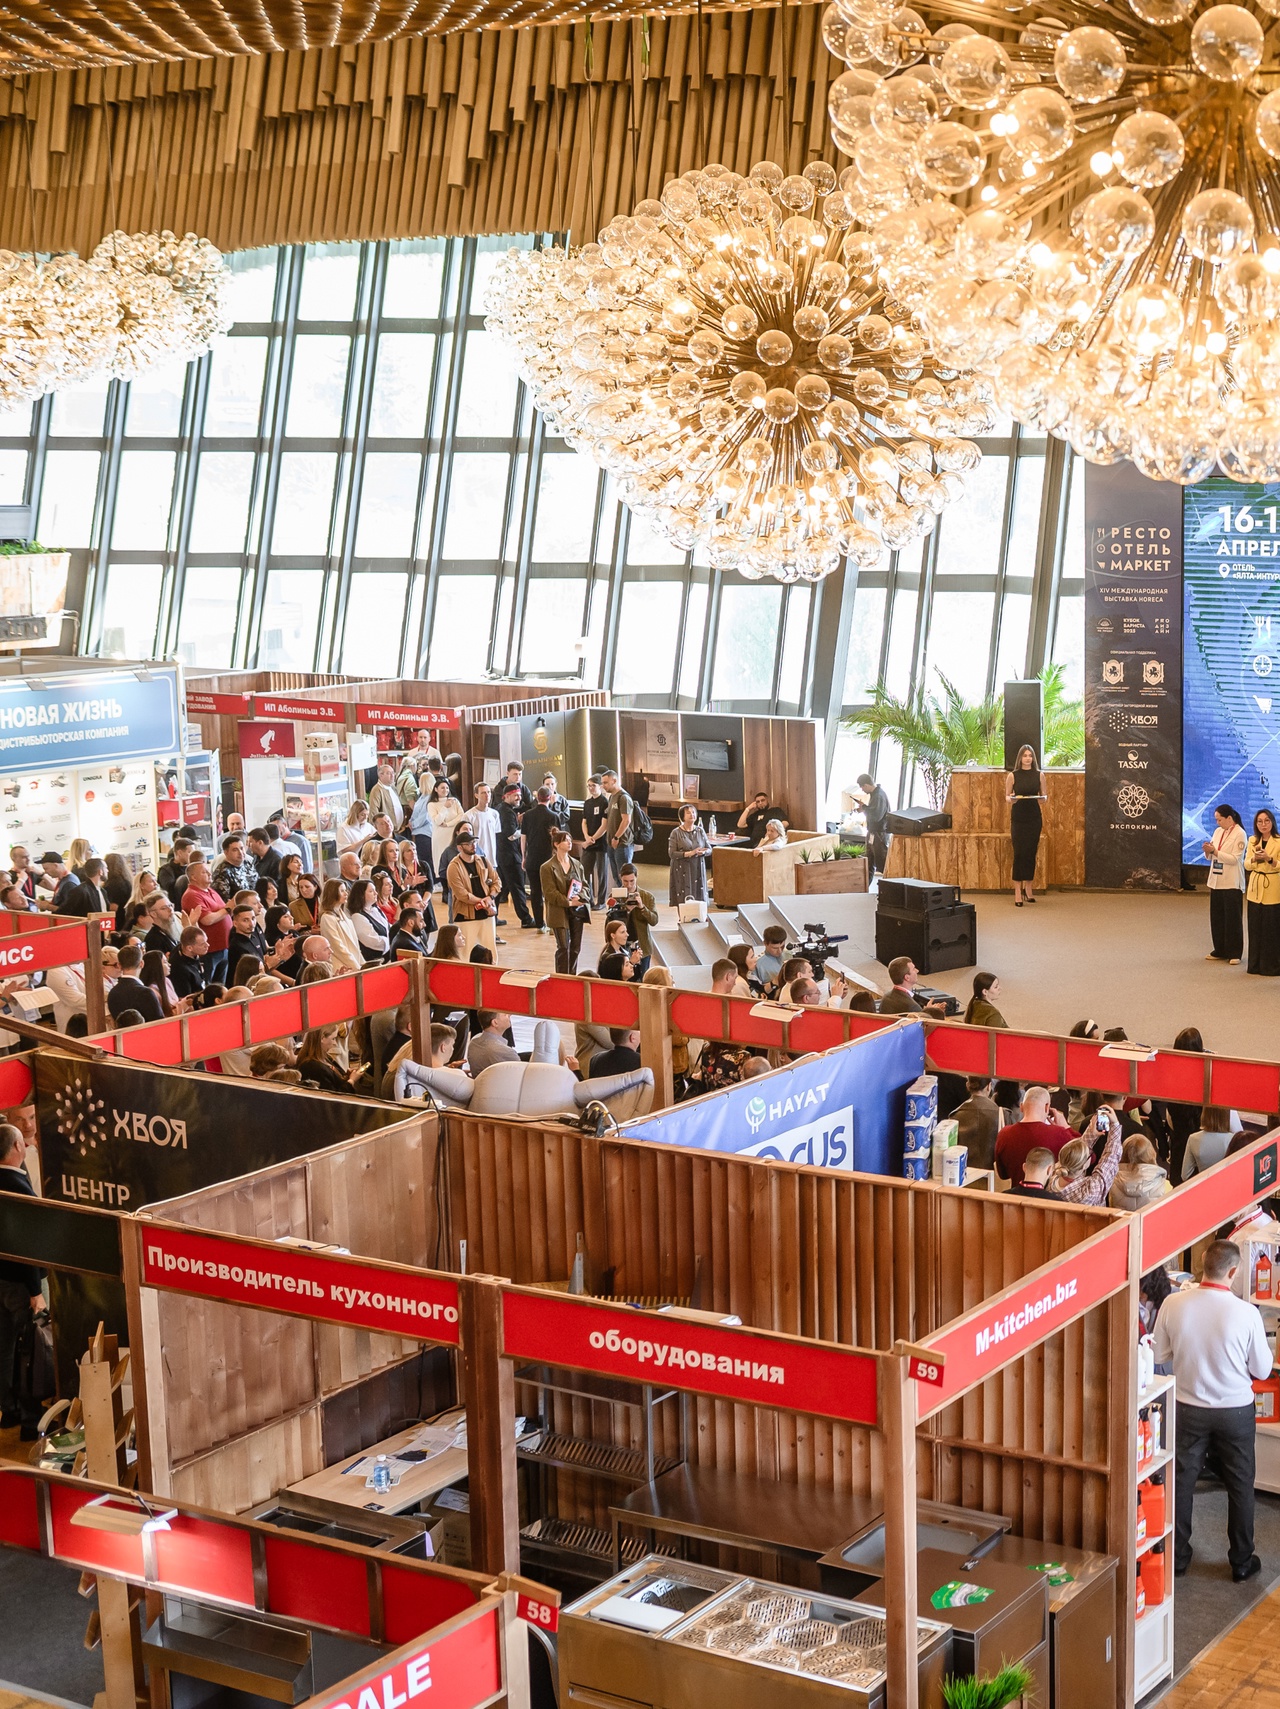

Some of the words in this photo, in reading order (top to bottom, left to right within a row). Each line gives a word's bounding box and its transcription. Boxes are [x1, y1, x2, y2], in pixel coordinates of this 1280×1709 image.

[1111, 527, 1171, 539] РЕСТО
[1110, 543, 1171, 555] ОТЕЛЬ
[1110, 559, 1171, 572] МАРКЕТ
[1232, 563, 1256, 572] ОТЕЛЬ
[1111, 587, 1169, 595] МЕЖДУНАРОДНАЯ
[0, 703, 60, 730] НОВАЯ
[62, 698, 123, 724] ЖИЗНЬ
[264, 702, 277, 712] ИП
[277, 703, 318, 716] Аболиньш
[319, 706, 336, 717] Э.В.
[367, 709, 381, 719] ИП
[382, 711, 429, 722] Аболиньш
[430, 712, 450, 724] Э.В.
[1130, 715, 1158, 725] ХВОЯ
[0, 730, 85, 750] ДИСТРИБЬЮТОРСКАЯ
[85, 725, 130, 740] КОМПАНИЯ
[1118, 760, 1149, 769] TASSAY
[100, 919, 112, 929] 12
[769, 1082, 830, 1122] HAYAT
[112, 1108, 188, 1150] ХВОЯ
[61, 1174, 131, 1206] ЦЕНТР
[147, 1245, 325, 1299] Производитель
[330, 1285, 459, 1324] кухонного
[975, 1277, 1078, 1357] M-kitchen.biz
[588, 1329, 785, 1386] оборудования
[916, 1361, 939, 1381] 59
[526, 1600, 551, 1625] 58
[330, 1652, 433, 1709] ALE
